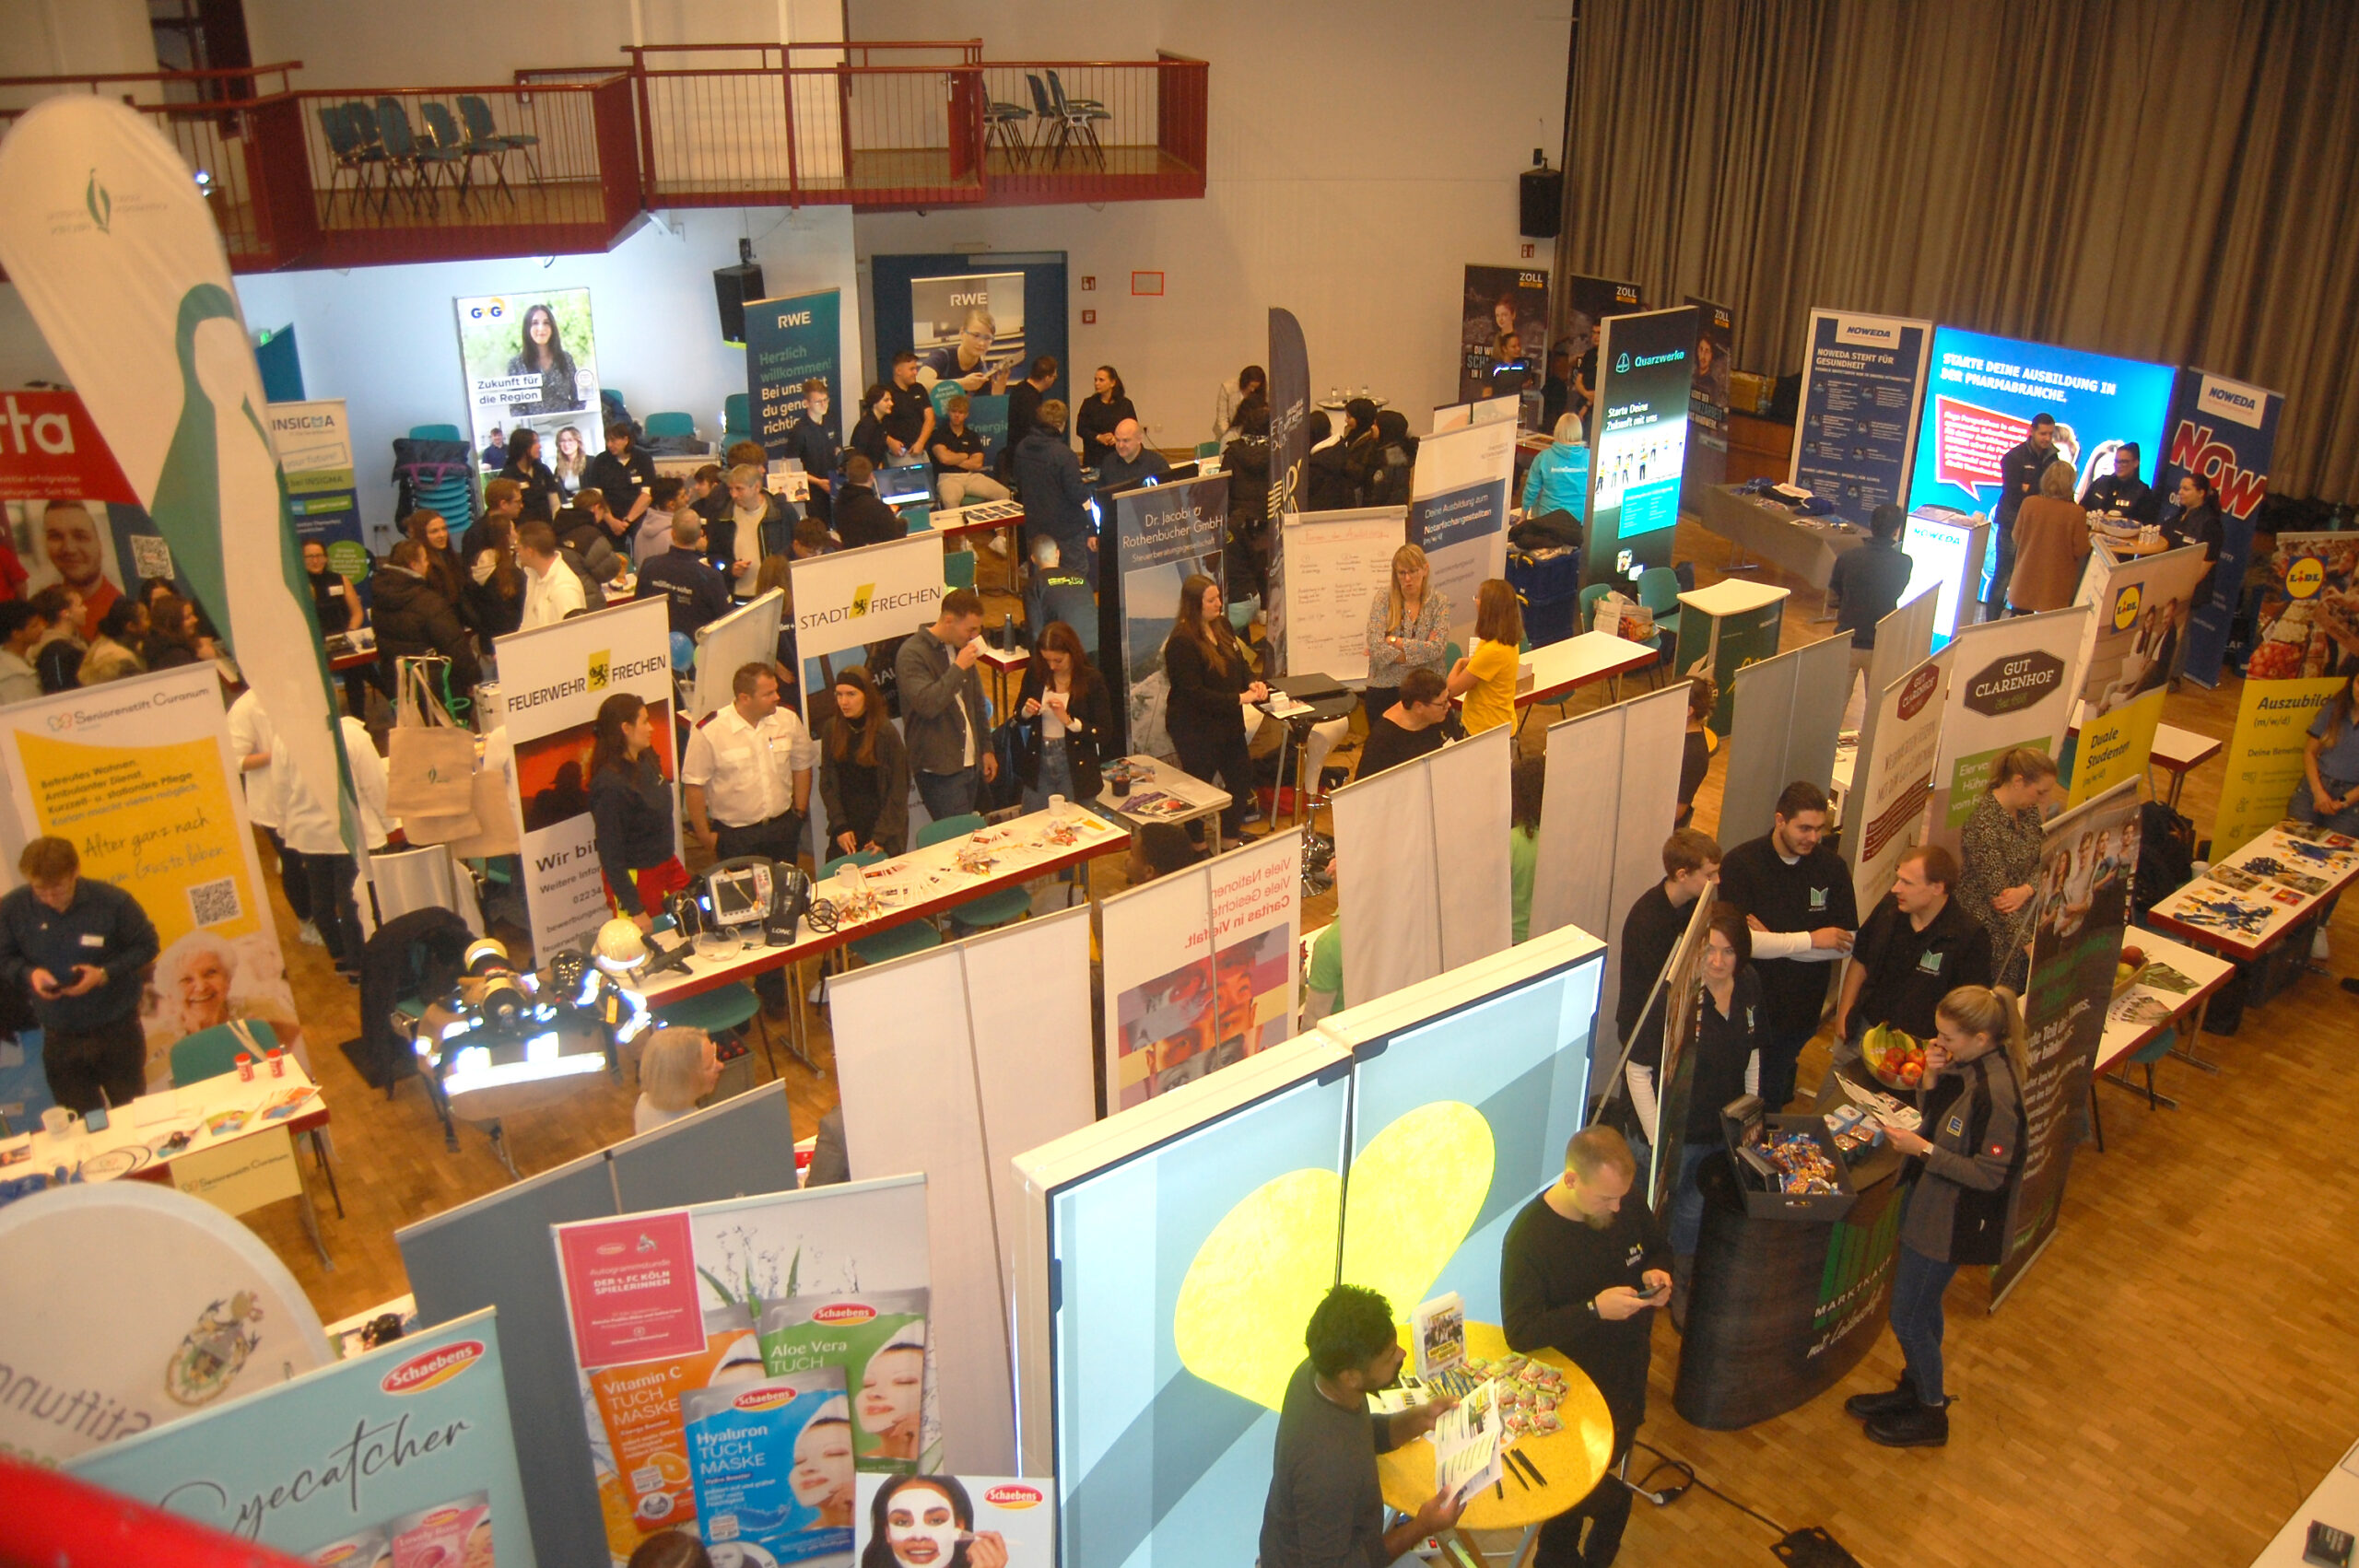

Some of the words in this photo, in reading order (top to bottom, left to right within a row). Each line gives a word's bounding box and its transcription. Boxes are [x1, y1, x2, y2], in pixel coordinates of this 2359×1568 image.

[1520, 273, 1543, 282] ZOLL
[951, 293, 987, 306] RWE
[1616, 287, 1637, 298] ZOLL
[471, 306, 502, 319] GVG
[778, 311, 811, 329] RWE
[1715, 310, 1730, 322] ZOLL
[1847, 326, 1891, 337] NOWEDA
[759, 346, 807, 366] Herzlich
[1635, 350, 1685, 368] Quarzwerke
[1817, 348, 1849, 359] NOWEDA
[761, 357, 831, 383] willkommen!
[1816, 357, 1865, 369] GESUNDHEIT
[477, 378, 521, 390] Zukunft
[523, 375, 538, 385] für
[1943, 353, 1984, 370] STARTE
[1986, 361, 2021, 378] DEINE
[2022, 369, 2098, 392] AUSBILDUNG
[2100, 381, 2116, 395] IN
[761, 384, 779, 400] Bei
[781, 382, 802, 395] uns
[1941, 368, 1963, 383] DER
[1965, 373, 2067, 403] PHARMABRANCHE.
[479, 395, 496, 404] die
[499, 391, 538, 404] Region
[2209, 387, 2255, 409] NOWEDA
[763, 405, 778, 417] du
[273, 416, 334, 431] INSIGMA
[2169, 419, 2267, 520] NOW
[1145, 514, 1159, 527] Dr.
[1162, 506, 1190, 526] Jacobi
[1193, 515, 1223, 533] GmbH
[800, 606, 850, 630] STADT
[871, 587, 941, 614] FRECHEN
[2003, 659, 2032, 676] GUT
[509, 677, 585, 712] FEUERWEHR
[612, 654, 666, 682] FRECHEN
[1976, 670, 2054, 697] CLARENHOF
[74, 700, 151, 725] Seniorenstift
[153, 687, 210, 707] Curanum
[2090, 727, 2118, 749] Duale
[2086, 741, 2130, 769] Studenten
[535, 852, 569, 872] Wir
[540, 875, 576, 894] Weitere
[593, 1277, 615, 1287] DER
[640, 1270, 670, 1281] KÖLN
[594, 1279, 671, 1295] SPIELERINNEN
[818, 1307, 869, 1319] Schaebens
[770, 1342, 806, 1358] Aloe
[811, 1340, 847, 1352] Vera
[391, 1346, 473, 1386] Schaebens
[770, 1357, 824, 1373] TUCH
[604, 1372, 665, 1395] Vitamin
[669, 1365, 683, 1379] C
[609, 1387, 663, 1410] TUCH
[738, 1390, 791, 1406] Schaebens
[613, 1398, 681, 1425] MASKE
[697, 1425, 768, 1445] Hyaluron
[699, 1441, 752, 1459] TUCH
[700, 1453, 766, 1474] MASKE
[990, 1489, 1037, 1501] Schaebens
